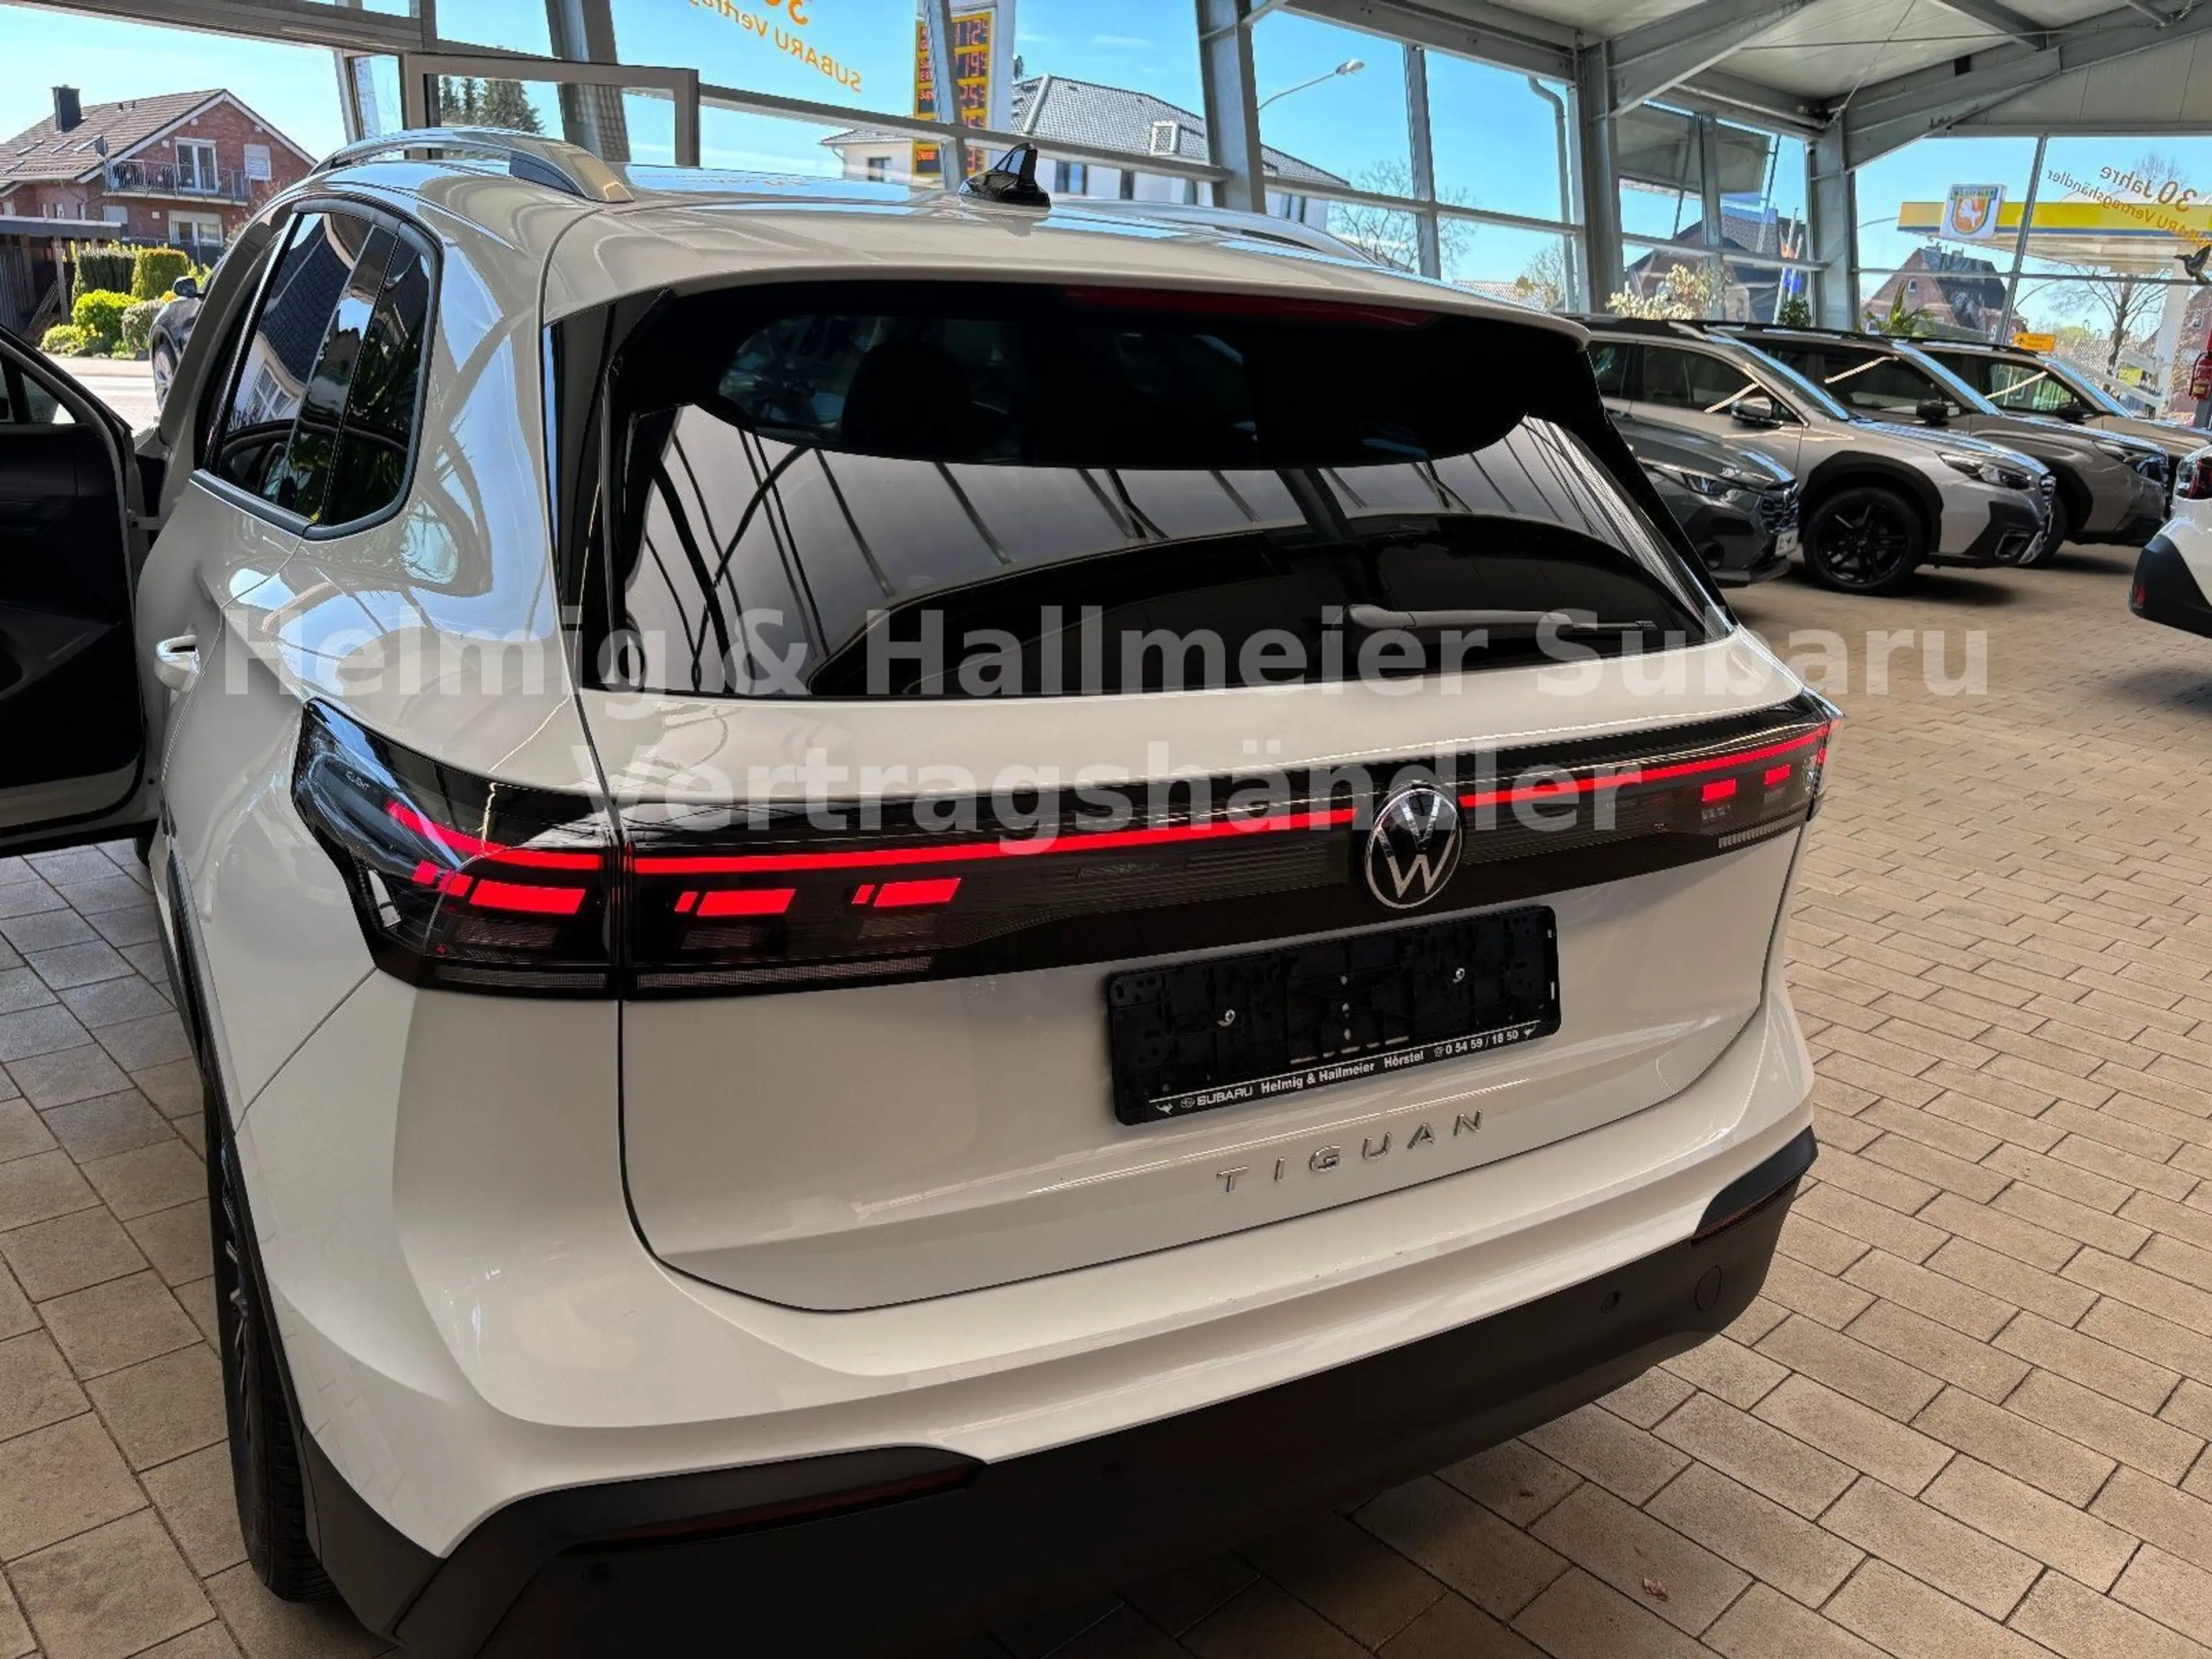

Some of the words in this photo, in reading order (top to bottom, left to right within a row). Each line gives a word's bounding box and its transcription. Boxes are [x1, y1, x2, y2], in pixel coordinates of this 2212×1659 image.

[1196, 1086, 1253, 1106] SUBARU
[1260, 1077, 1304, 1094] Helmig
[1306, 1073, 1317, 1085] &
[1319, 1062, 1376, 1082] Hallmeier
[1384, 1051, 1425, 1069] Hörstel
[1445, 1044, 1453, 1055] 0
[1455, 1040, 1468, 1053] 54
[1470, 1037, 1483, 1049] 59
[1506, 1029, 1519, 1041] 50
[1217, 1108, 1483, 1193] TIGUAN
